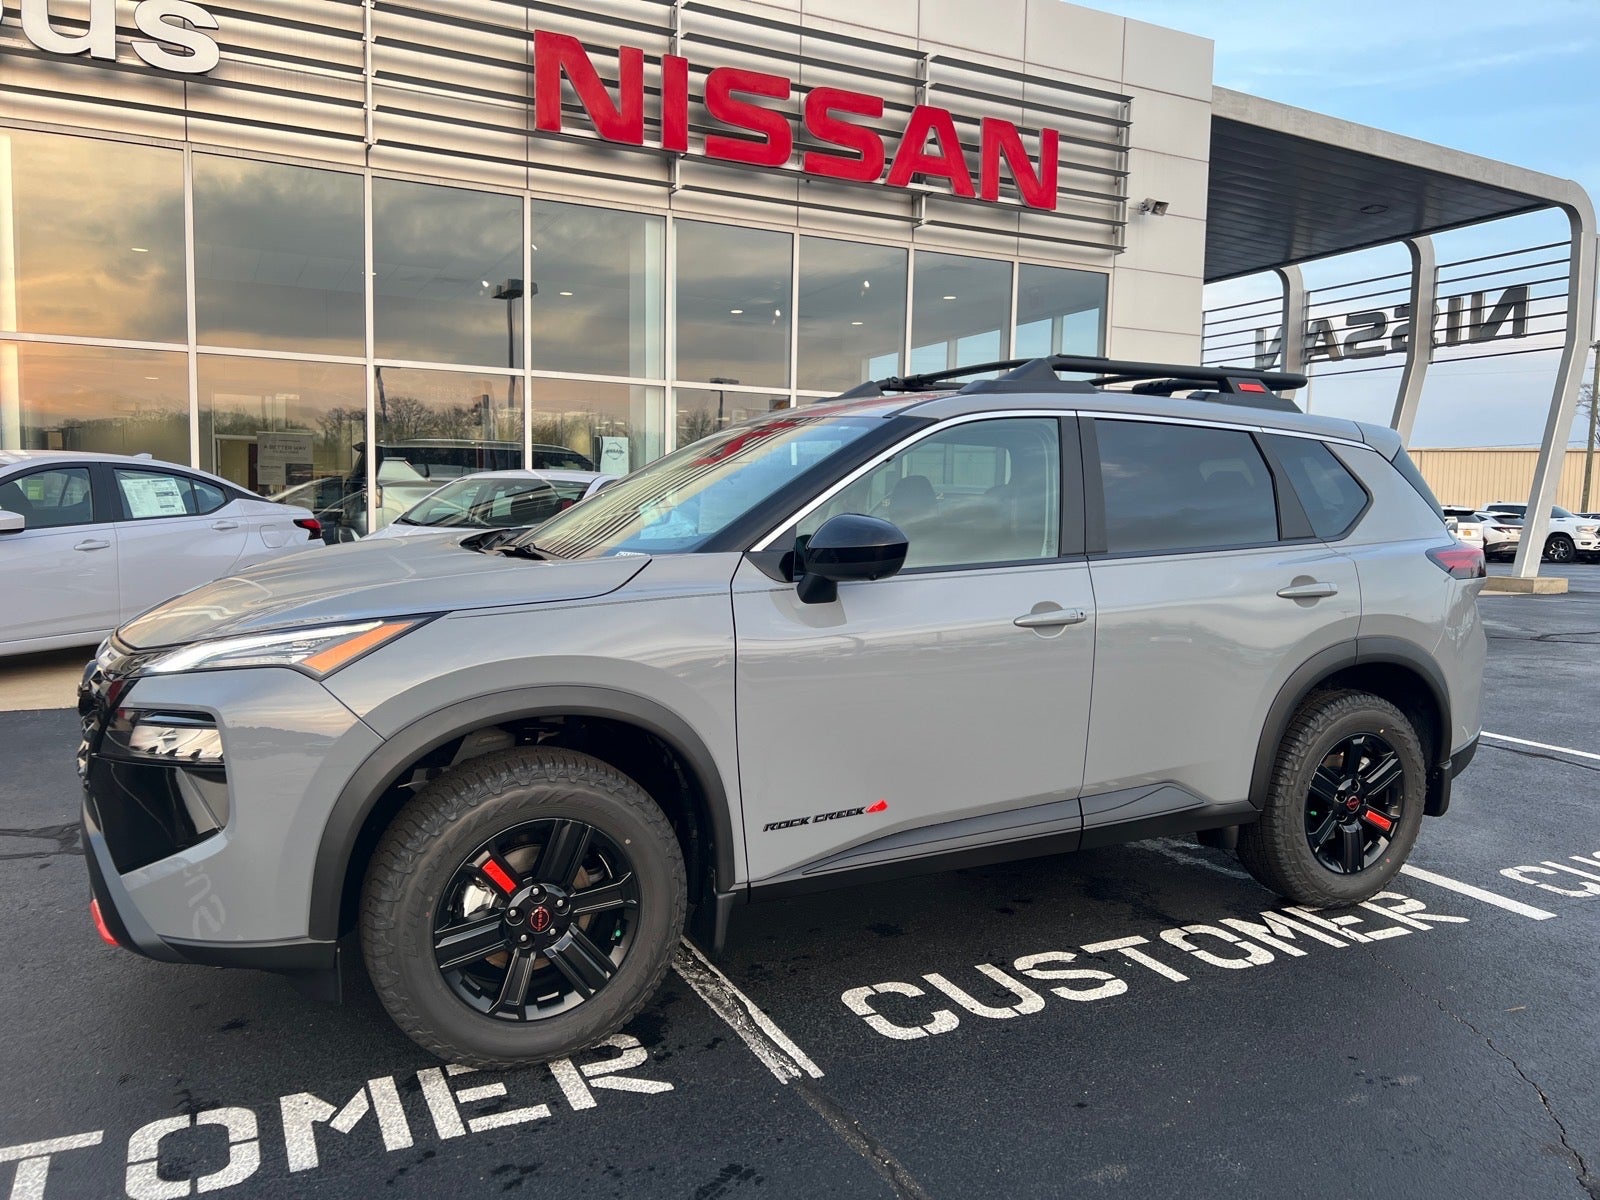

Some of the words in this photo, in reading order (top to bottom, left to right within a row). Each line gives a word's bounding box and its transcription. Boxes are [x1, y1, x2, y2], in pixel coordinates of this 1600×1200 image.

[0, 0, 220, 73] us
[534, 29, 1060, 211] NISSAN
[763, 816, 811, 832] ROCK
[812, 806, 867, 823] CREEK
[841, 891, 1470, 1039] CUSTOMER
[0, 1033, 674, 1200] TOMER
